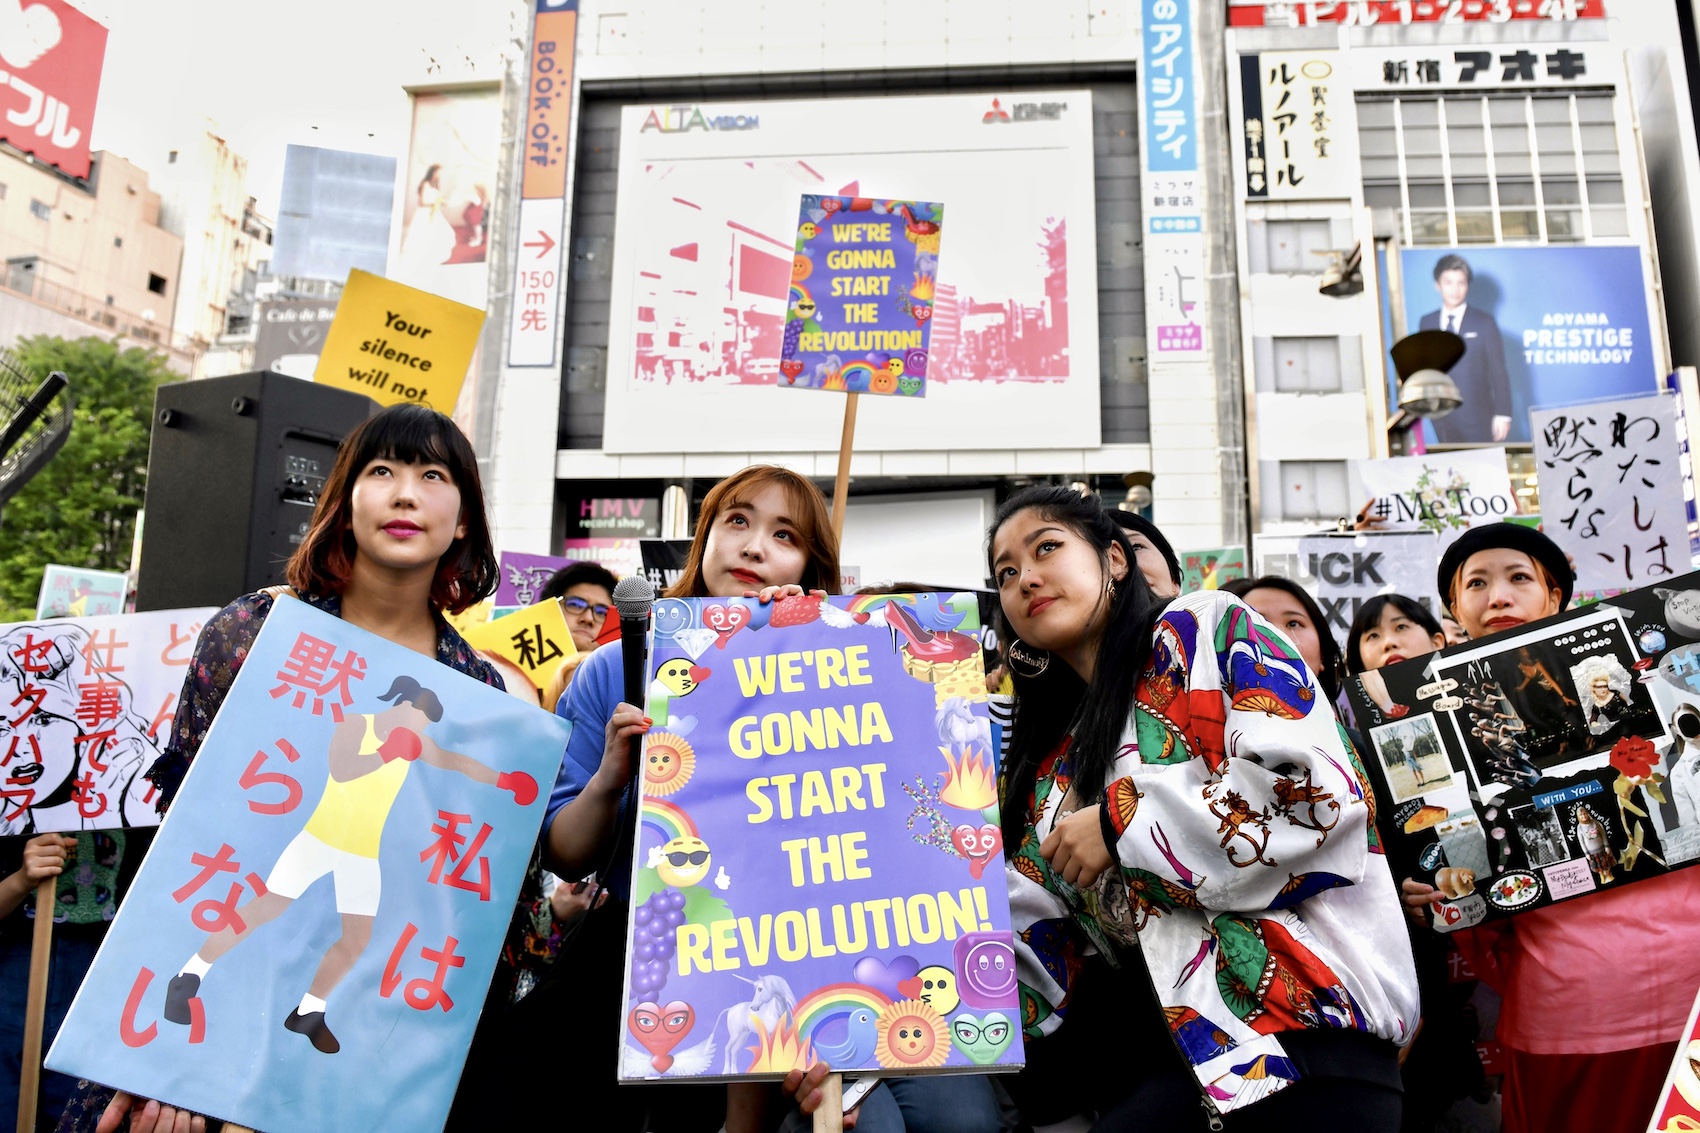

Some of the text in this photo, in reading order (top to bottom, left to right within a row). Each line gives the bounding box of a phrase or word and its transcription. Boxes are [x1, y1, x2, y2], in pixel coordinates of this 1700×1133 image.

[0, 70, 81, 149] フル
[1269, 62, 1304, 187] ルノアール
[832, 223, 891, 243] WE'RE
[827, 249, 896, 269] GONNA
[831, 276, 891, 297] START
[384, 310, 432, 339] Your
[843, 303, 879, 324] THE
[1542, 312, 1609, 326] AOYAMA
[360, 338, 432, 372] silence
[799, 330, 922, 353] REVOLUTION!
[1523, 327, 1633, 348] PRESTIGE
[1525, 349, 1633, 364] TECHNOLOGY
[349, 366, 428, 402] will not
[580, 499, 645, 517] HMV
[1376, 486, 1509, 524] #MeToo
[1543, 416, 1634, 580] 黙らない
[1609, 412, 1674, 577] わたしは
[579, 515, 645, 530] record shop
[1263, 552, 1386, 590] FUCK
[733, 645, 873, 698] WE'RE
[0, 634, 54, 822] セクハラ
[71, 628, 129, 819] 仕事でも
[728, 701, 893, 760] GONNA
[746, 763, 888, 824] START
[1540, 792, 1566, 806] WITH
[119, 632, 367, 1048] 黙らない
[781, 832, 872, 888] THE
[379, 810, 494, 1012] 私は
[676, 886, 993, 976] REVOLUTION!
